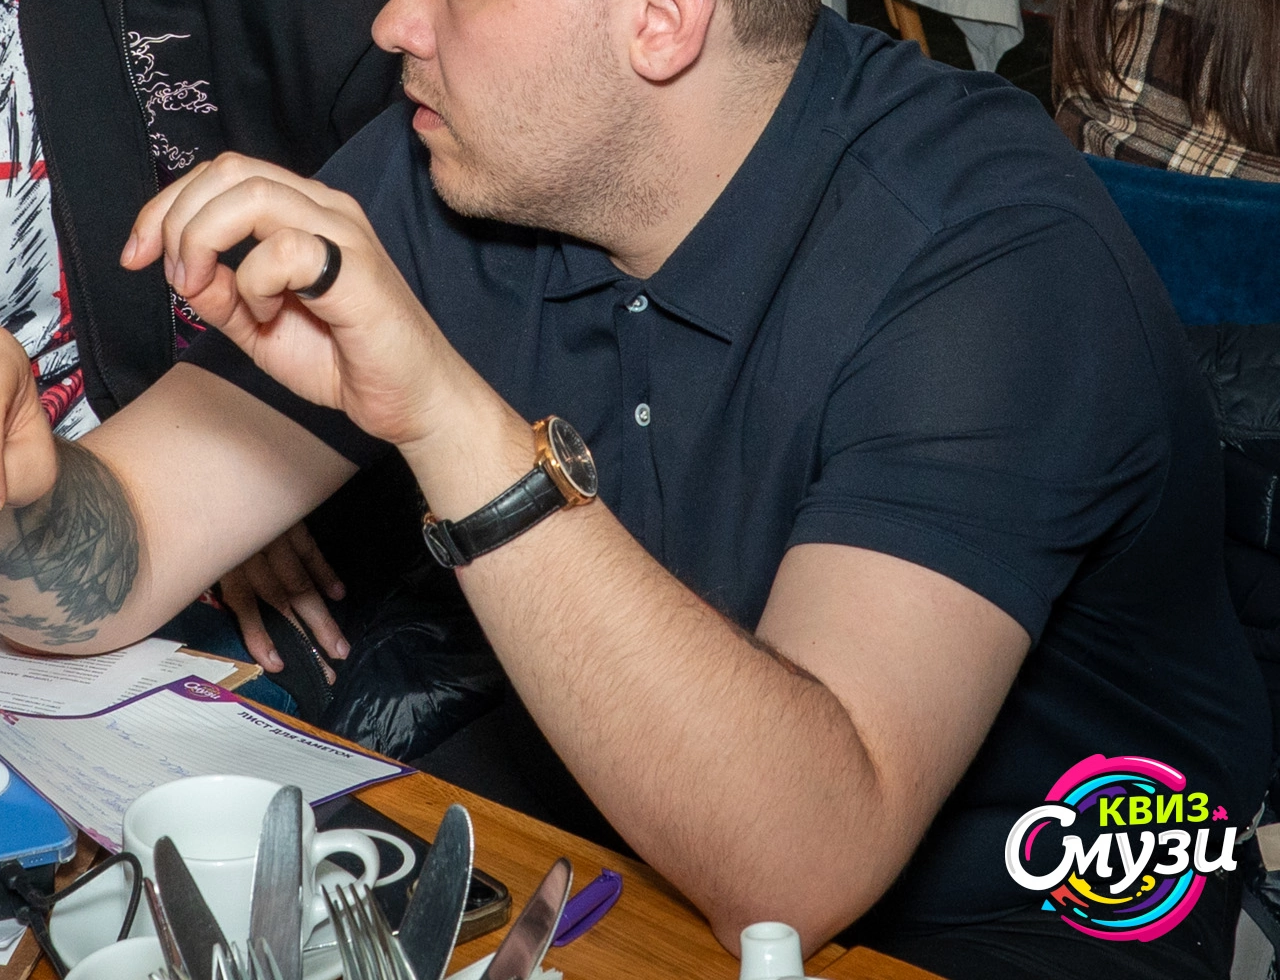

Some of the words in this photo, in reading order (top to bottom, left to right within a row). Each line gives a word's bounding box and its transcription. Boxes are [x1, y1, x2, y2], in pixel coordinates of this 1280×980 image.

[237, 711, 273, 730] ЛИСТ
[268, 727, 298, 741] ДЛЯ
[296, 738, 355, 759] ЗАМЕТОК
